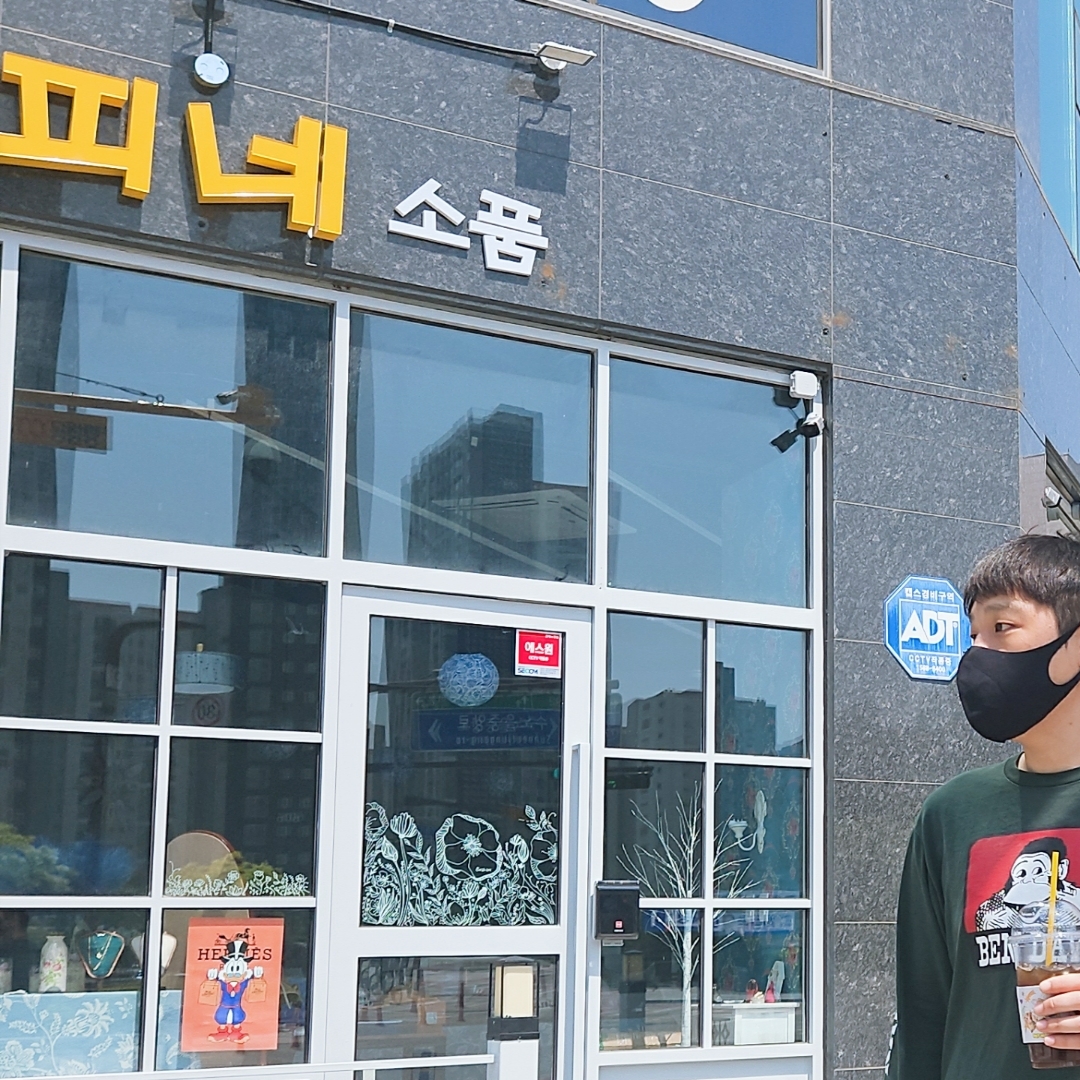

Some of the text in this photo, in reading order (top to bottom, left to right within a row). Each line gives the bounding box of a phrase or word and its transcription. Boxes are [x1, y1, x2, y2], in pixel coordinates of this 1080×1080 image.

[388, 178, 550, 277] 소품
[901, 609, 958, 646] ADT
[524, 641, 554, 656] 에스원
